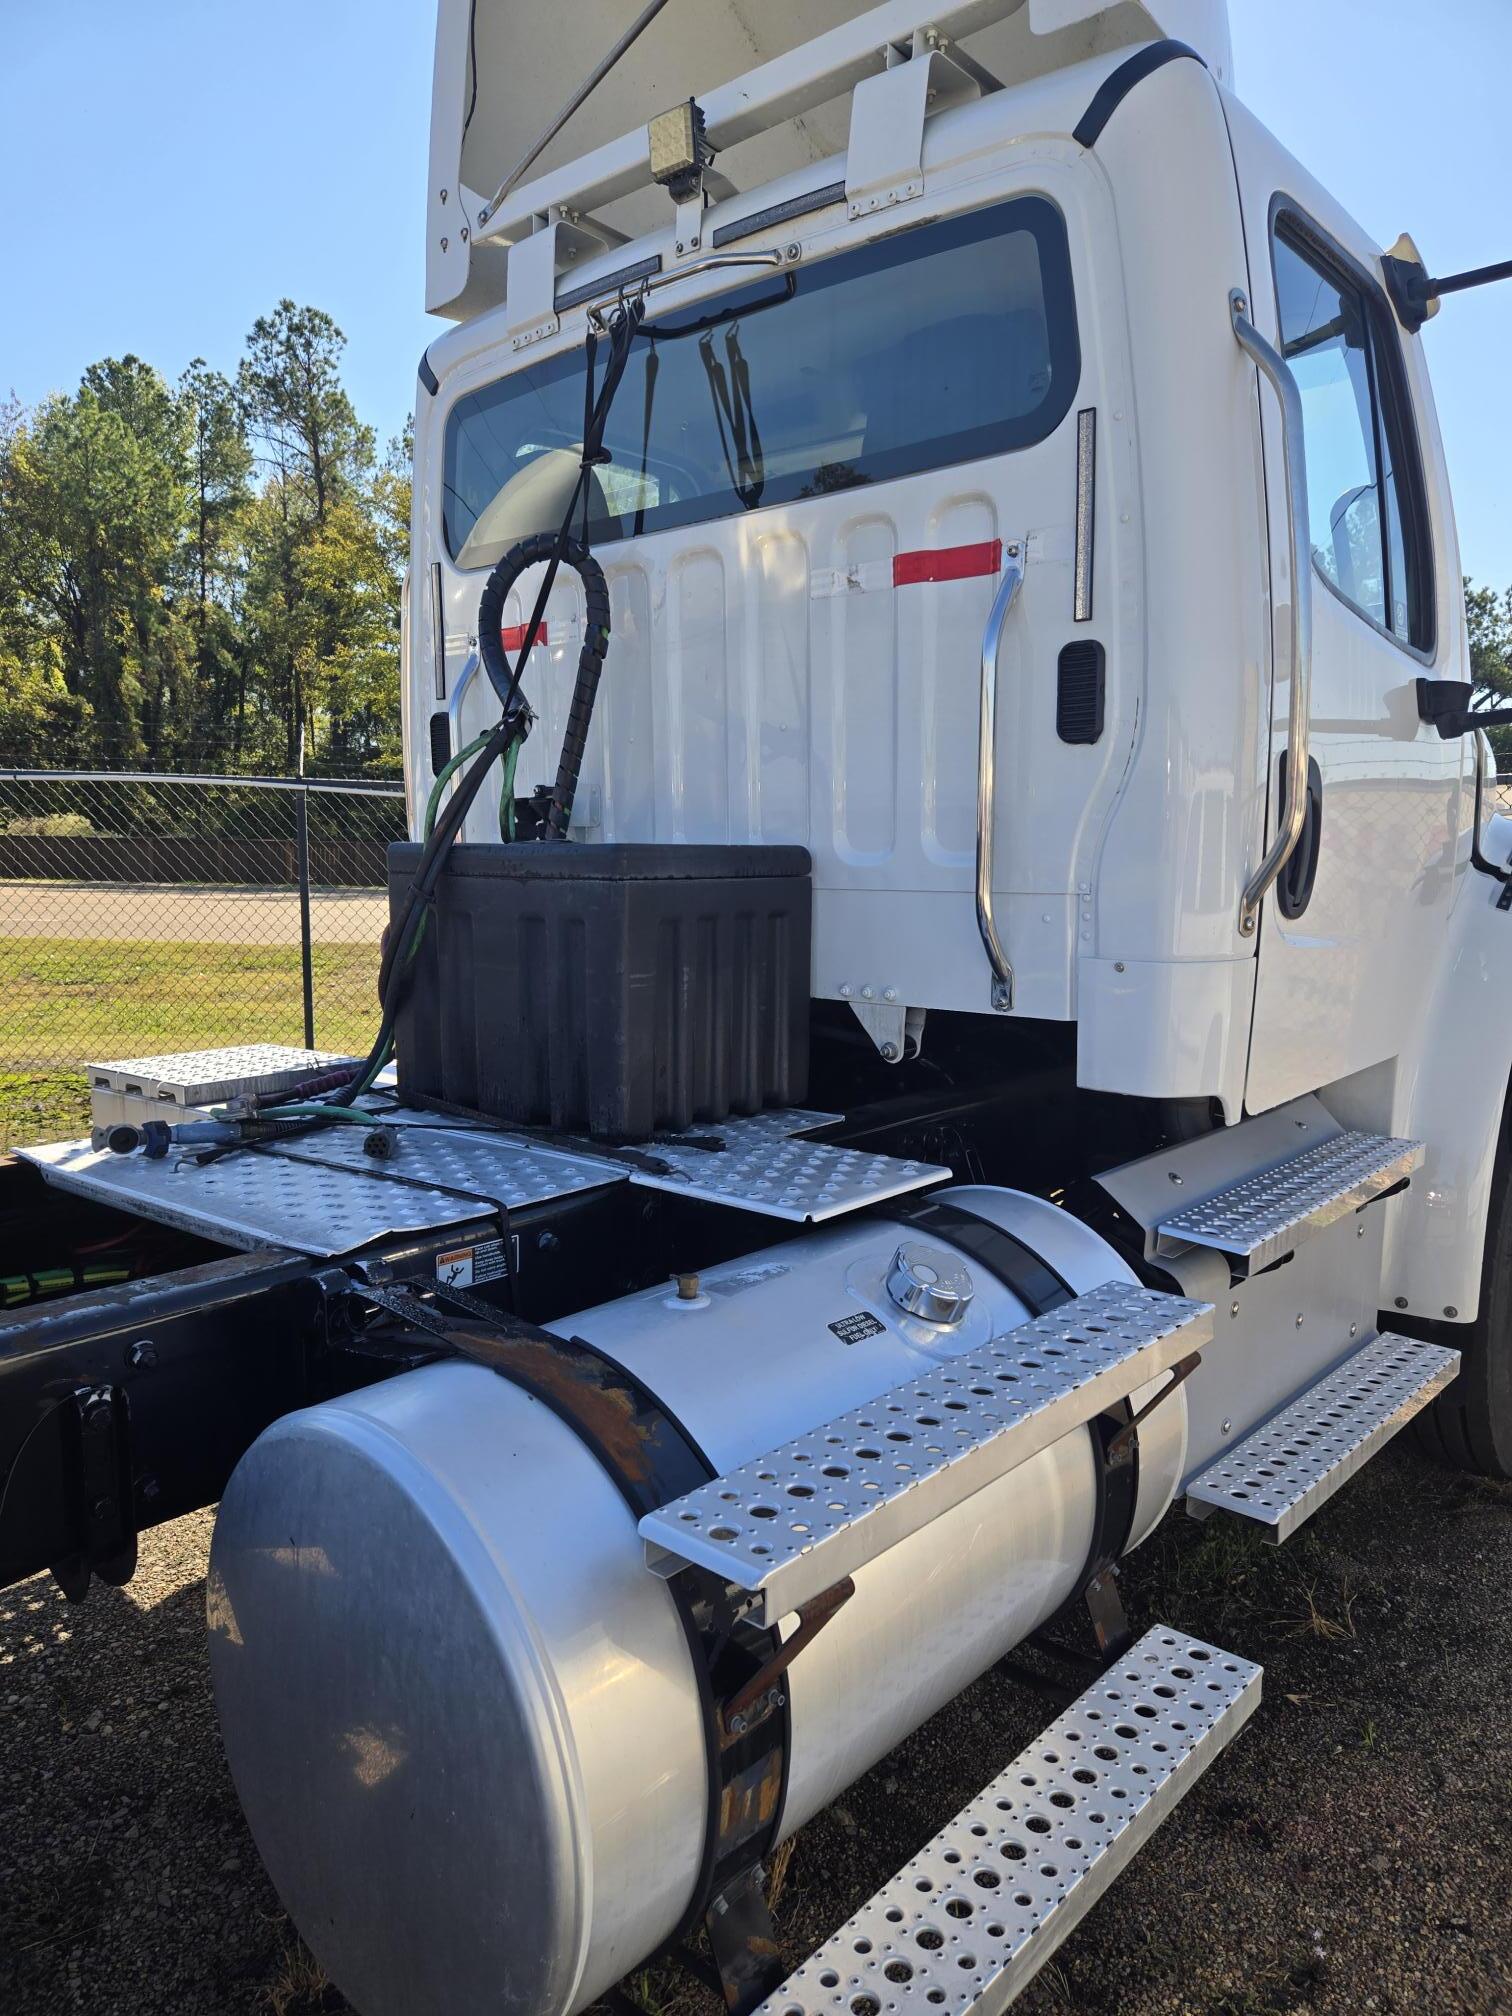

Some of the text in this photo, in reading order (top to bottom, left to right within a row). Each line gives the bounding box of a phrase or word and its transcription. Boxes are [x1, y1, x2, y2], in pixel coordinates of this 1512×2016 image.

[445, 1251, 471, 1262] WARNING
[835, 1318, 853, 1328] ULTRA
[849, 1332, 865, 1341] FUEL
